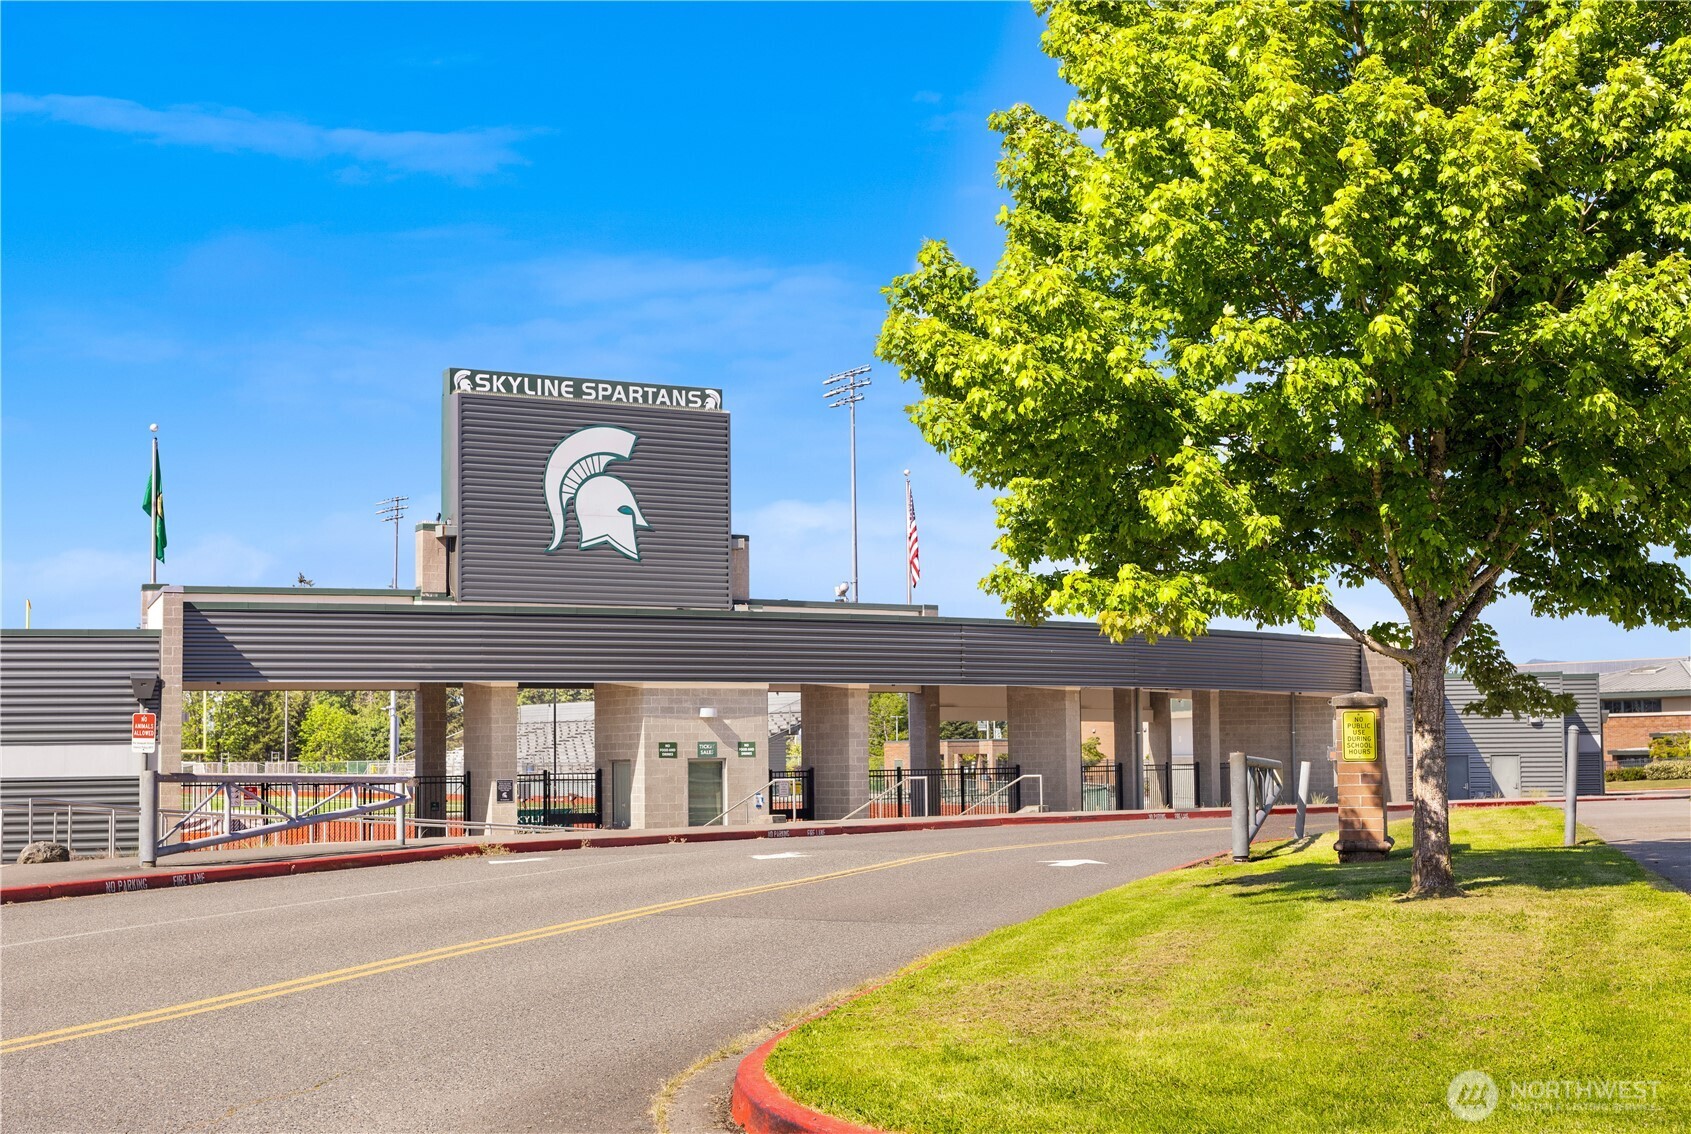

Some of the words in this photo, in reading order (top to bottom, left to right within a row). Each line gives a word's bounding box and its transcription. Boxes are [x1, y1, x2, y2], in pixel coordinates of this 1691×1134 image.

[474, 373, 574, 398] SKYLINE
[581, 382, 702, 408] SPARTANS
[105, 880, 116, 893] NO
[117, 877, 148, 891] PARKING
[172, 874, 187, 887] FIRE
[188, 872, 205, 885] LANE
